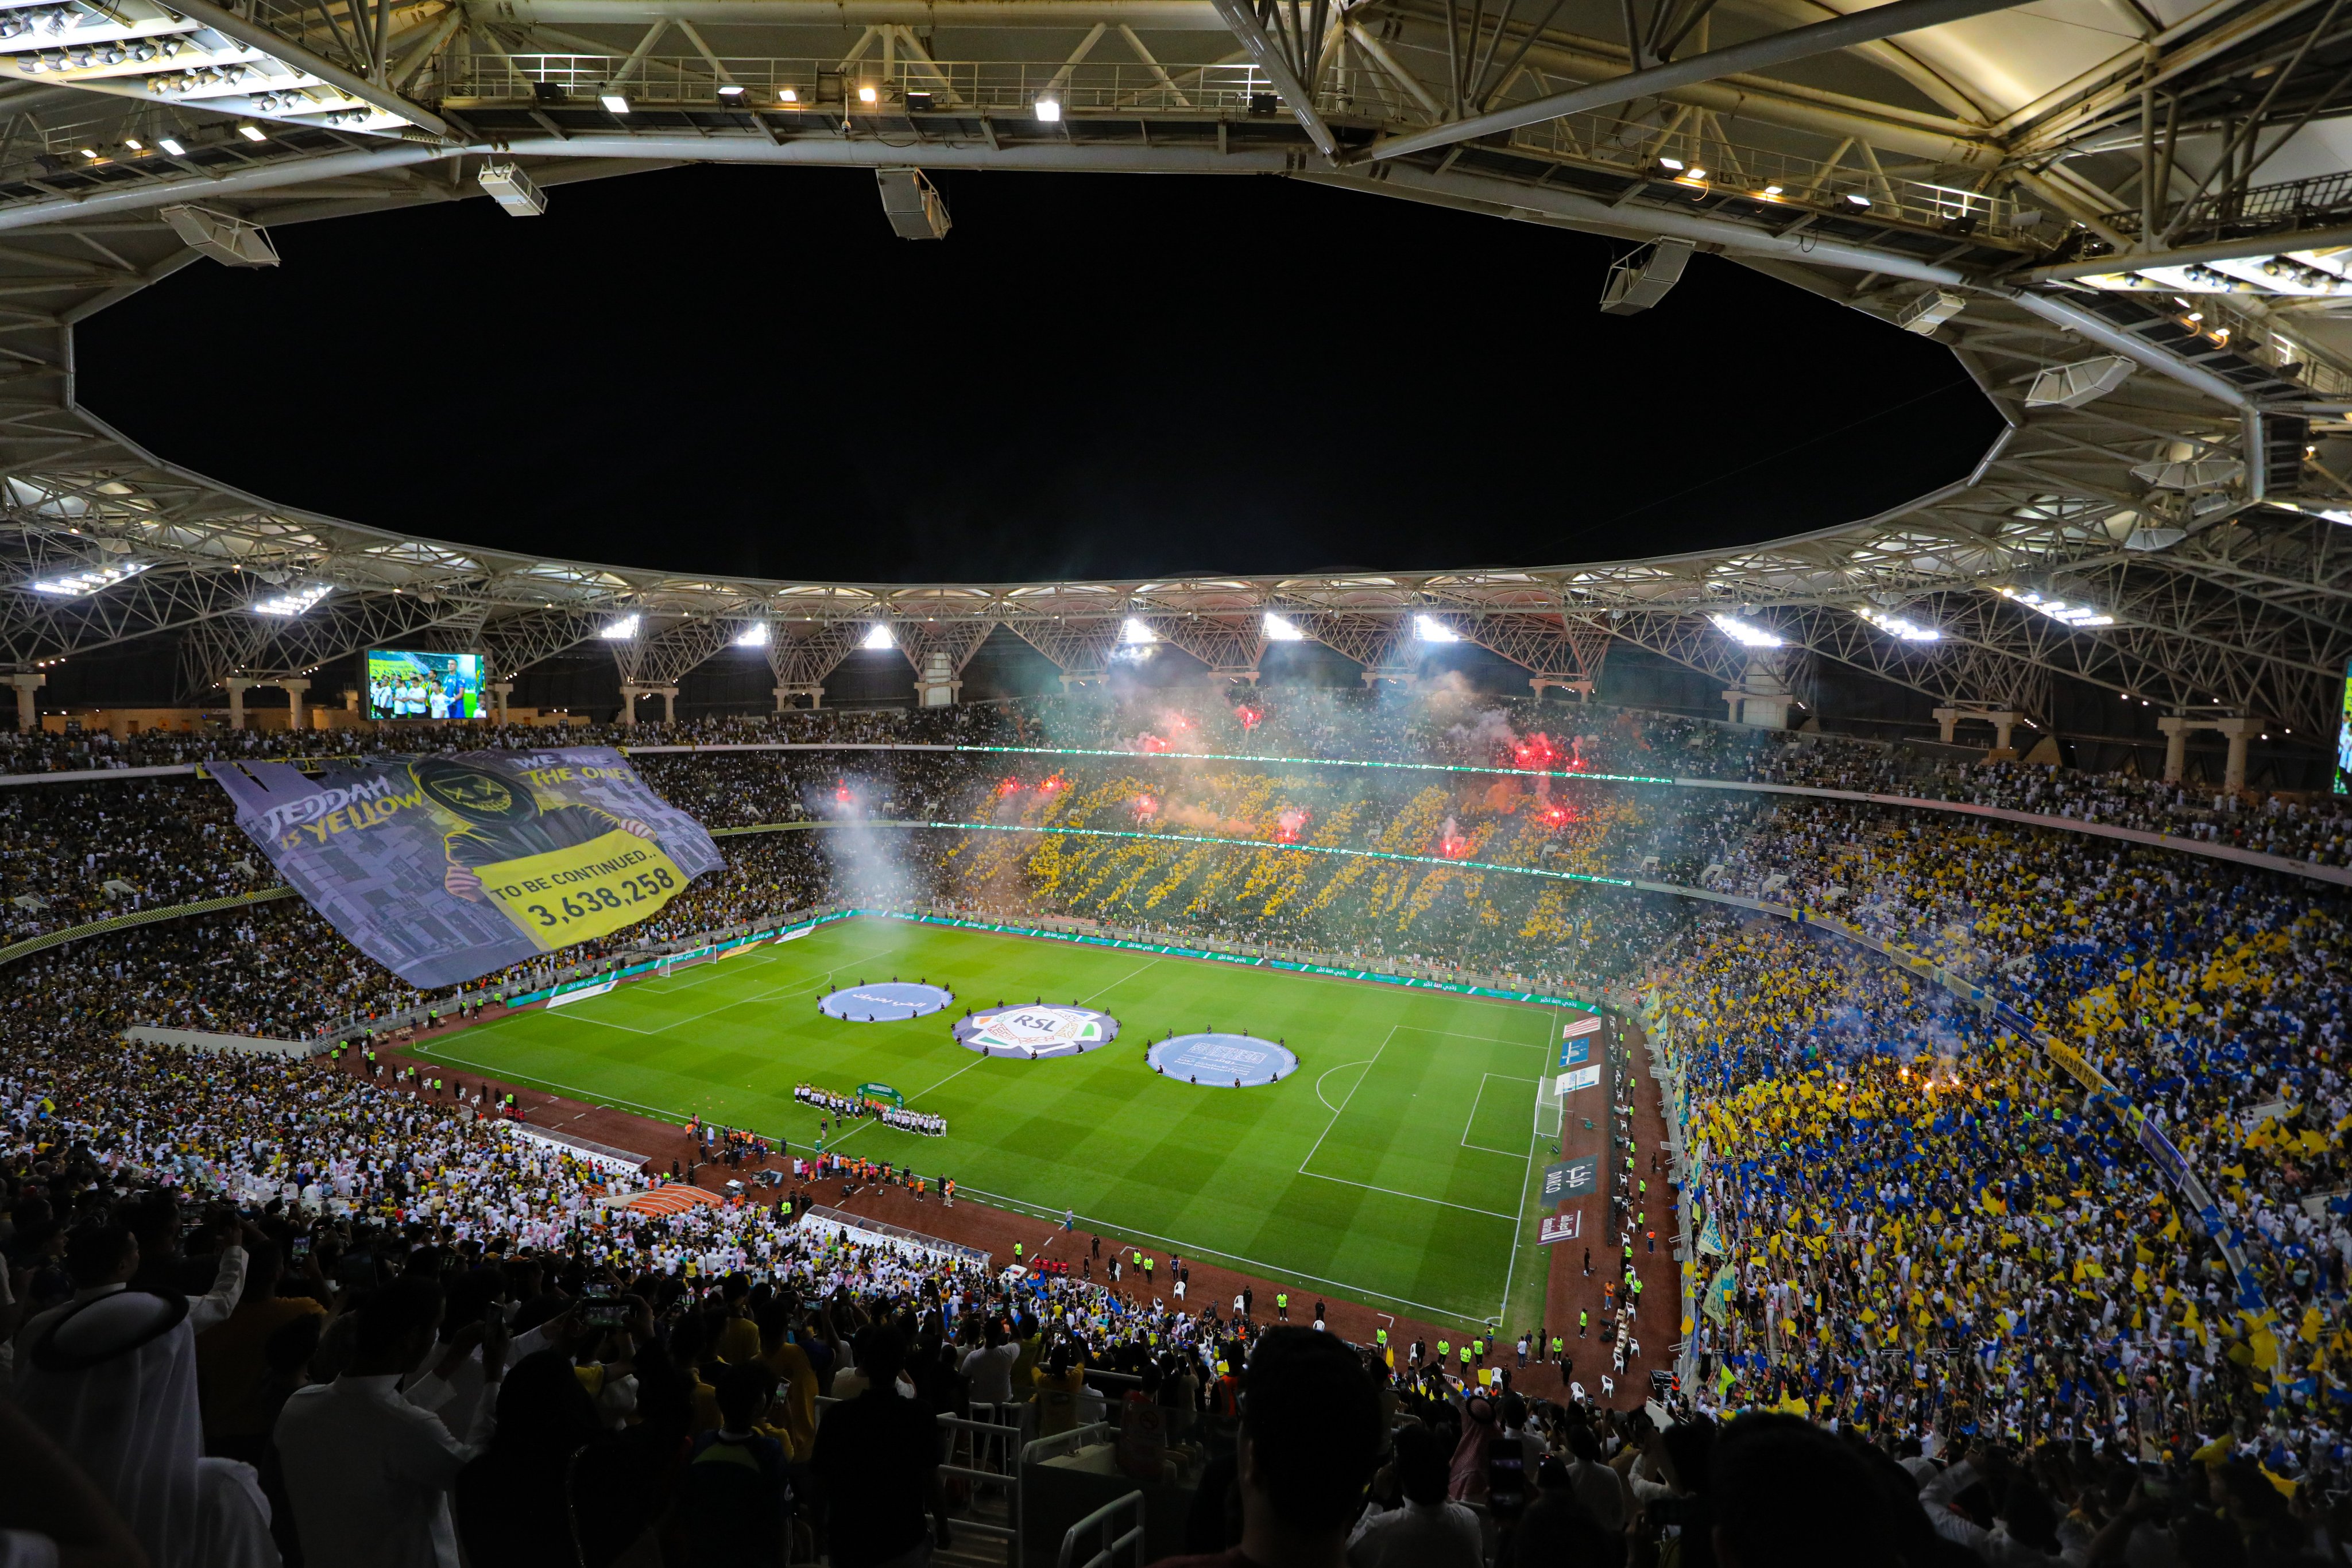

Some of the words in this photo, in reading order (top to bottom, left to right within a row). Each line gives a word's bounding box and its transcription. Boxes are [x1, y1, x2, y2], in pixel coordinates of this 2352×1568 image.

[517, 767, 574, 788] THE
[261, 775, 391, 844] JEDDAH
[281, 830, 302, 850] IS
[299, 789, 423, 845] YELLOW
[489, 885, 522, 901] TO
[521, 877, 552, 893] BE
[528, 868, 675, 927] 3,638,258
[1013, 1015, 1058, 1032] RSL
[1545, 1170, 1562, 1194] DARCO
